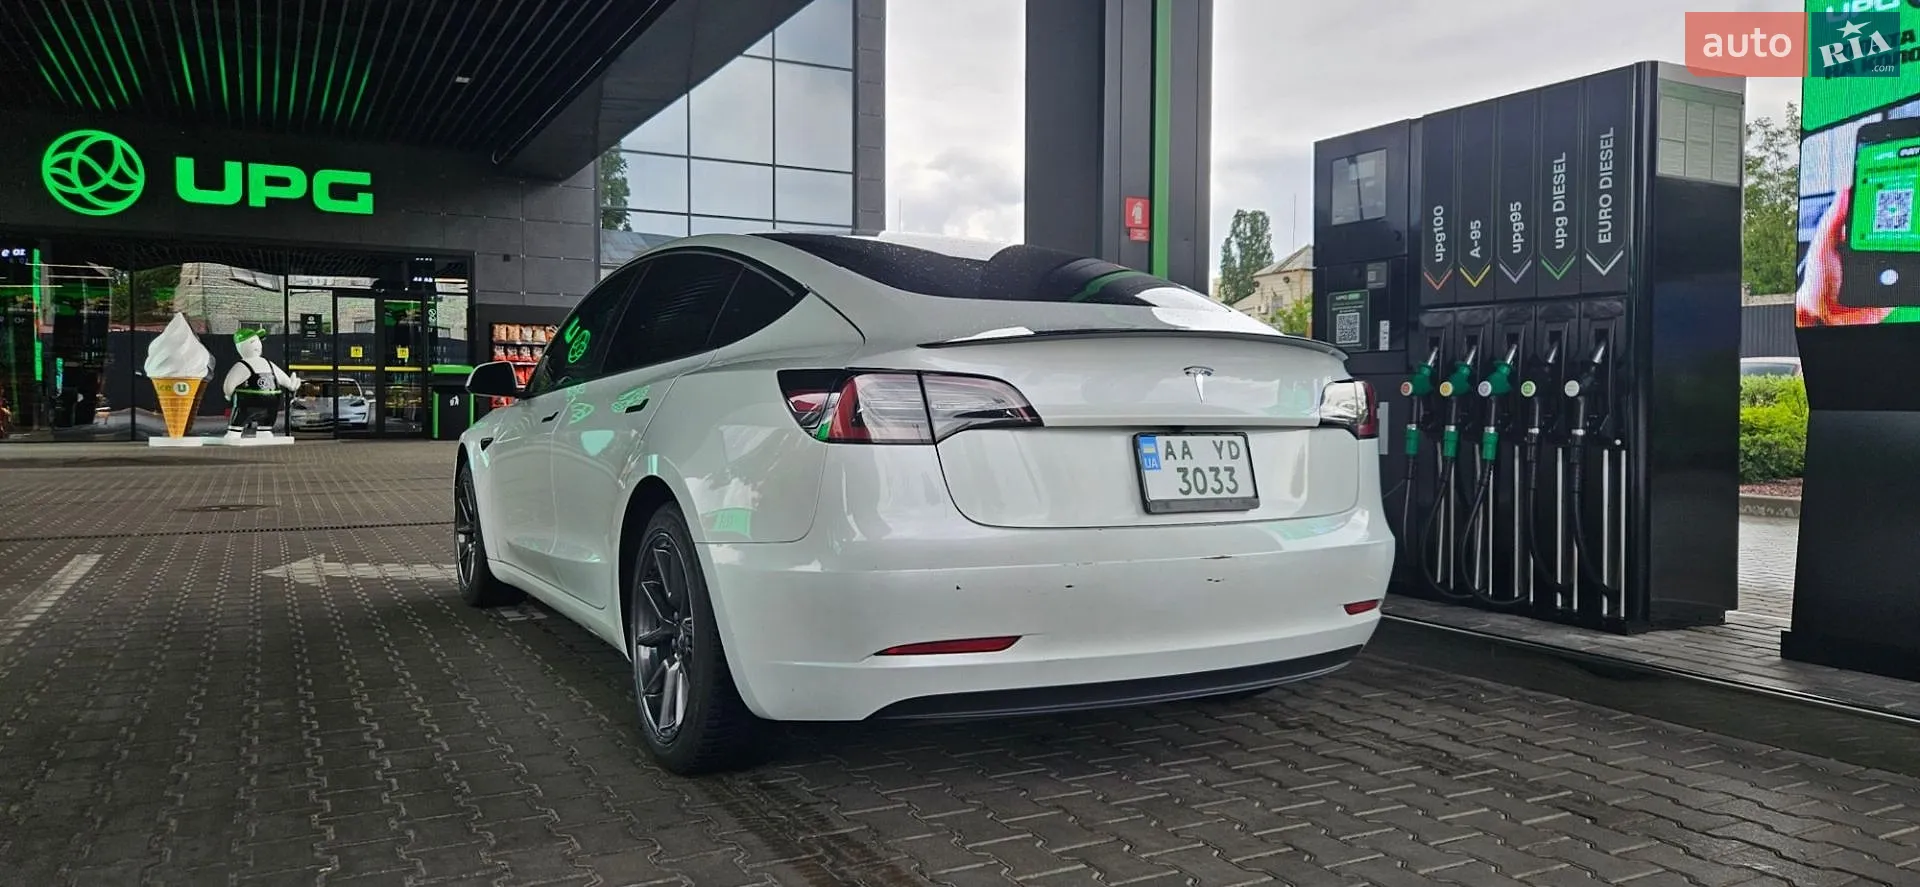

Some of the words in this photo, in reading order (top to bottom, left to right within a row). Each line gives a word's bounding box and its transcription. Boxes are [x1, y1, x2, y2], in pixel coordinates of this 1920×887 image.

[1553, 152, 1566, 212] DIESEL
[1599, 127, 1614, 188] DIESEL
[175, 157, 374, 215] UPG
[1433, 205, 1446, 263] upg100
[1470, 219, 1481, 258] A-95
[1510, 201, 1525, 253] upg95
[1555, 216, 1568, 249] upg
[1598, 194, 1612, 243] EURO
[1144, 457, 1158, 469] UA
[1164, 440, 1193, 461] AA
[1212, 439, 1240, 460] YD
[1176, 466, 1239, 495] 3033
